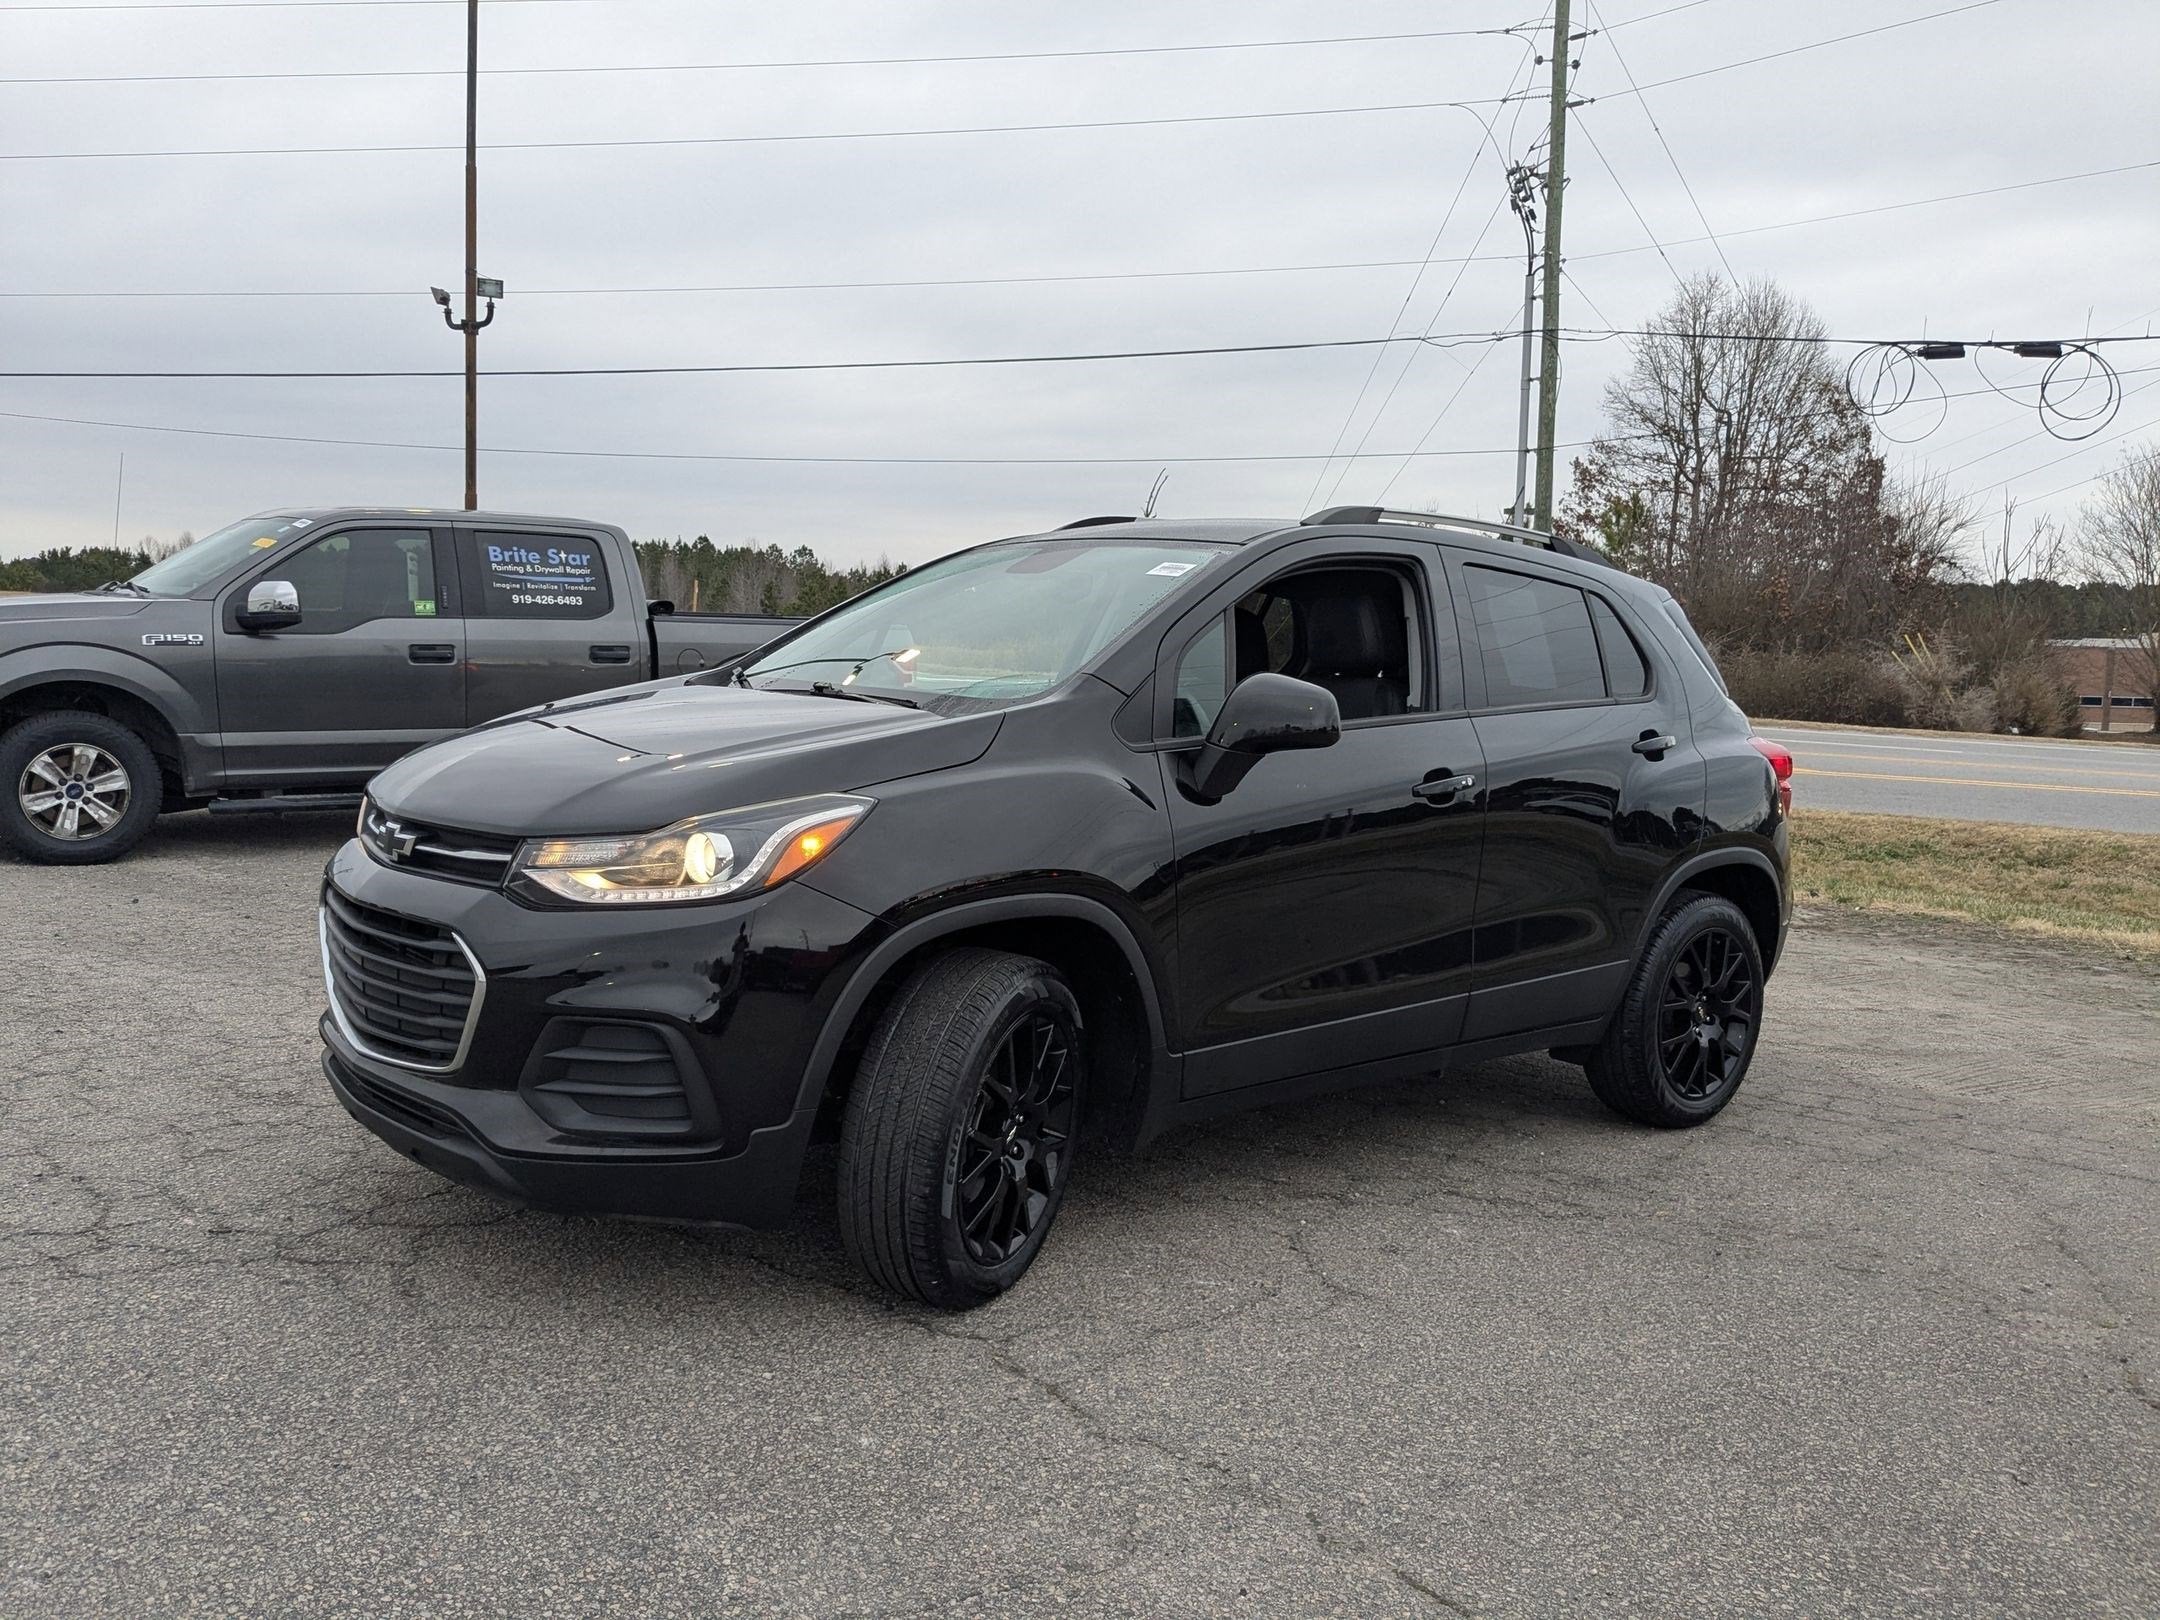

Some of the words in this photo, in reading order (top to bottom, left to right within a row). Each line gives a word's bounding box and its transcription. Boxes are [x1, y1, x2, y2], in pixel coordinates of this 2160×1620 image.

[488, 546, 541, 563] Brite
[547, 548, 590, 566] Star
[491, 563, 524, 574] Painting
[534, 565, 565, 574] Drywall
[566, 566, 591, 575] Repair
[512, 595, 583, 605] 919-426-6493
